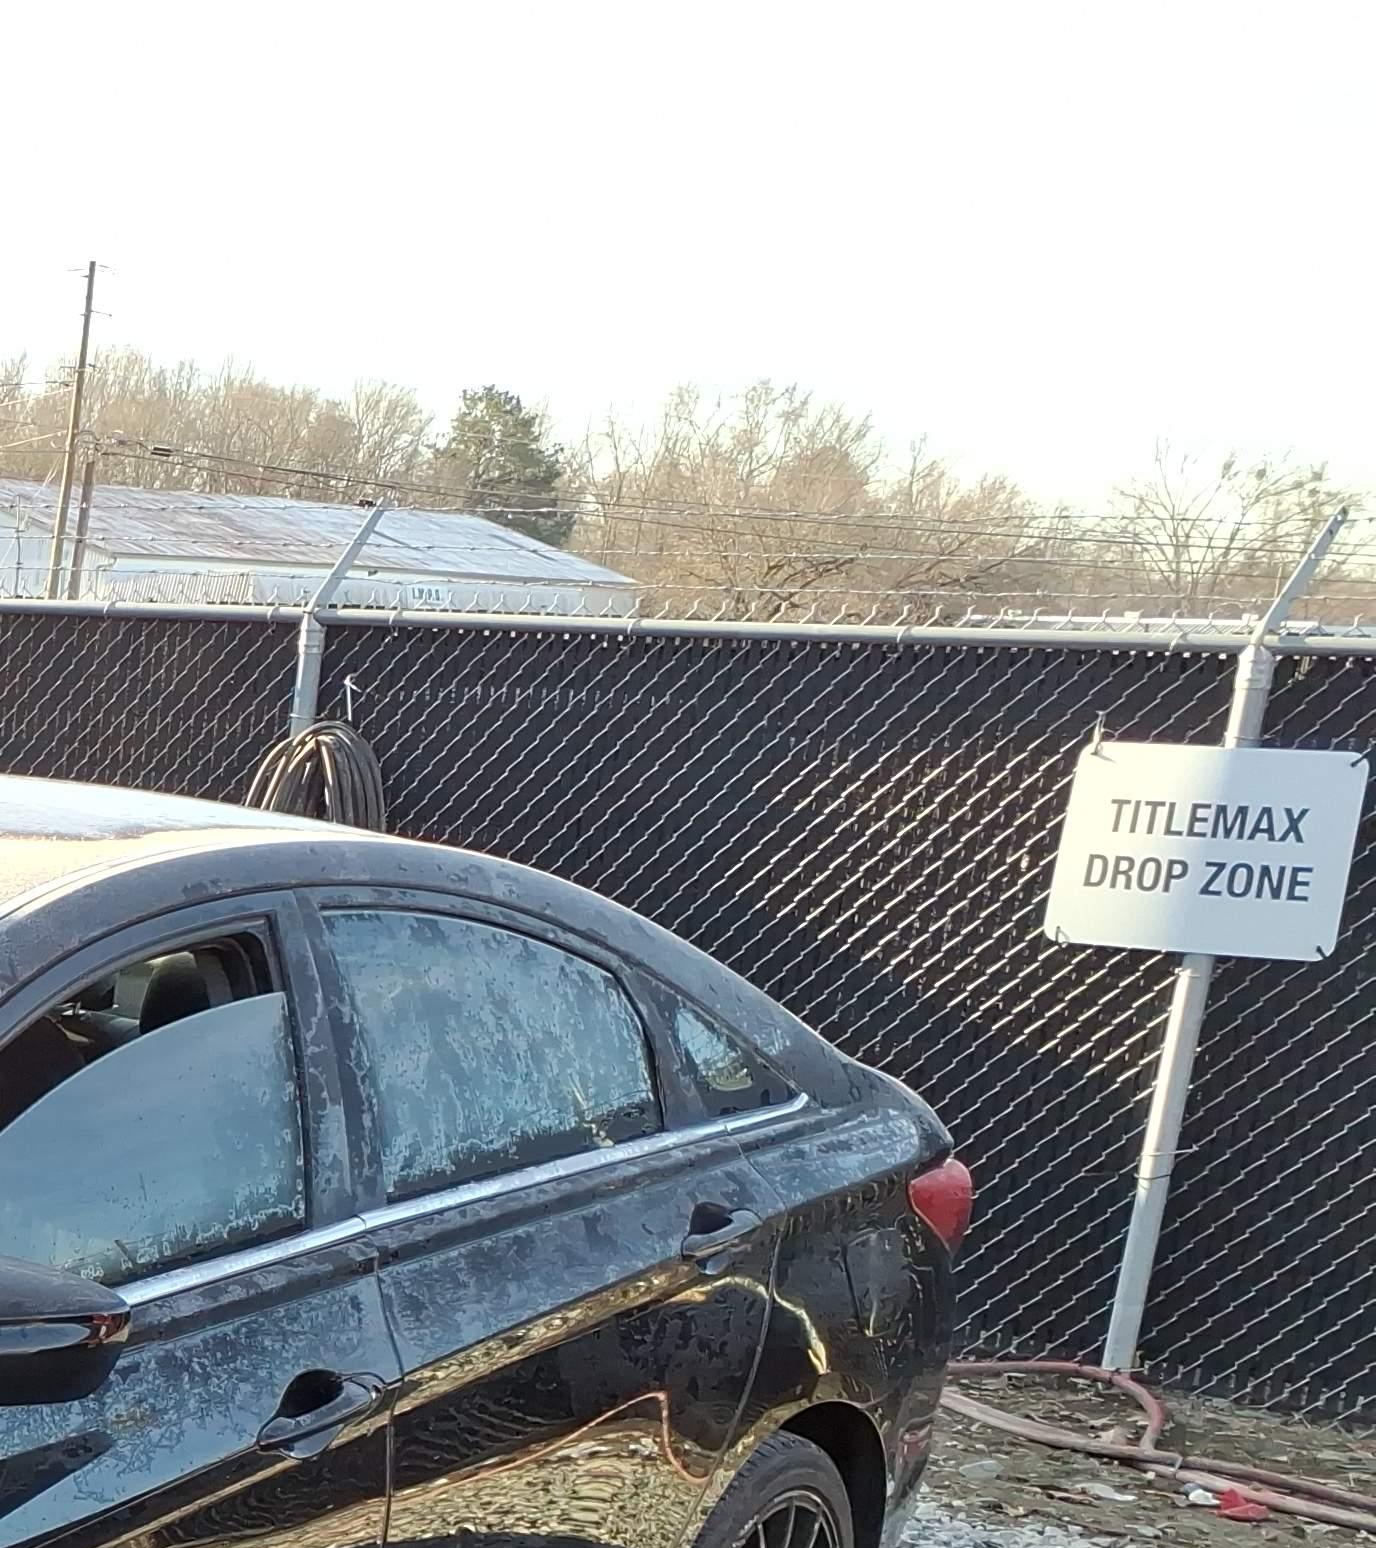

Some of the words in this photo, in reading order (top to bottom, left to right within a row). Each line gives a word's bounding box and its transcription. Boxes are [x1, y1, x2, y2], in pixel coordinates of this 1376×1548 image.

[1110, 799, 1310, 844] TITLEMAX
[1083, 853, 1190, 893] DROP
[1199, 861, 1314, 902] ZONE
